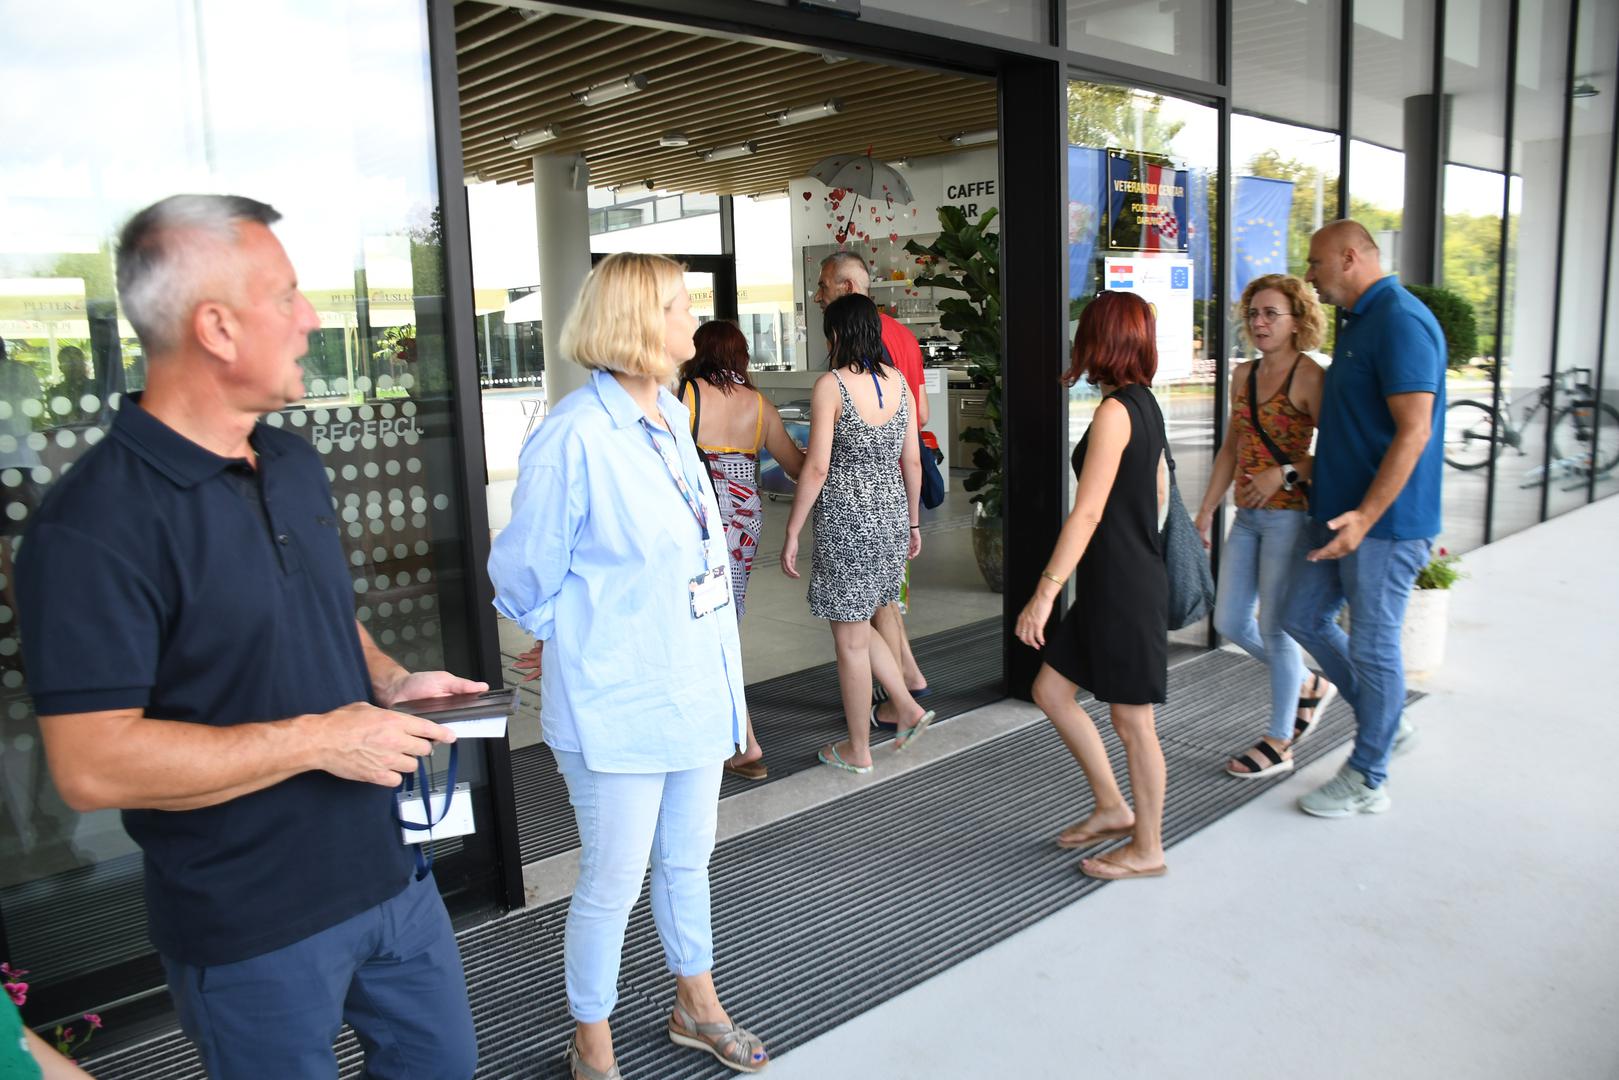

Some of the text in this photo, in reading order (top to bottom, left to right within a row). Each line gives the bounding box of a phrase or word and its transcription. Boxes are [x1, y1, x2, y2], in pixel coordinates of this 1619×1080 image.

[947, 180, 995, 200] CAFFE
[959, 204, 979, 218] AR
[312, 417, 424, 445] RECEPCI
